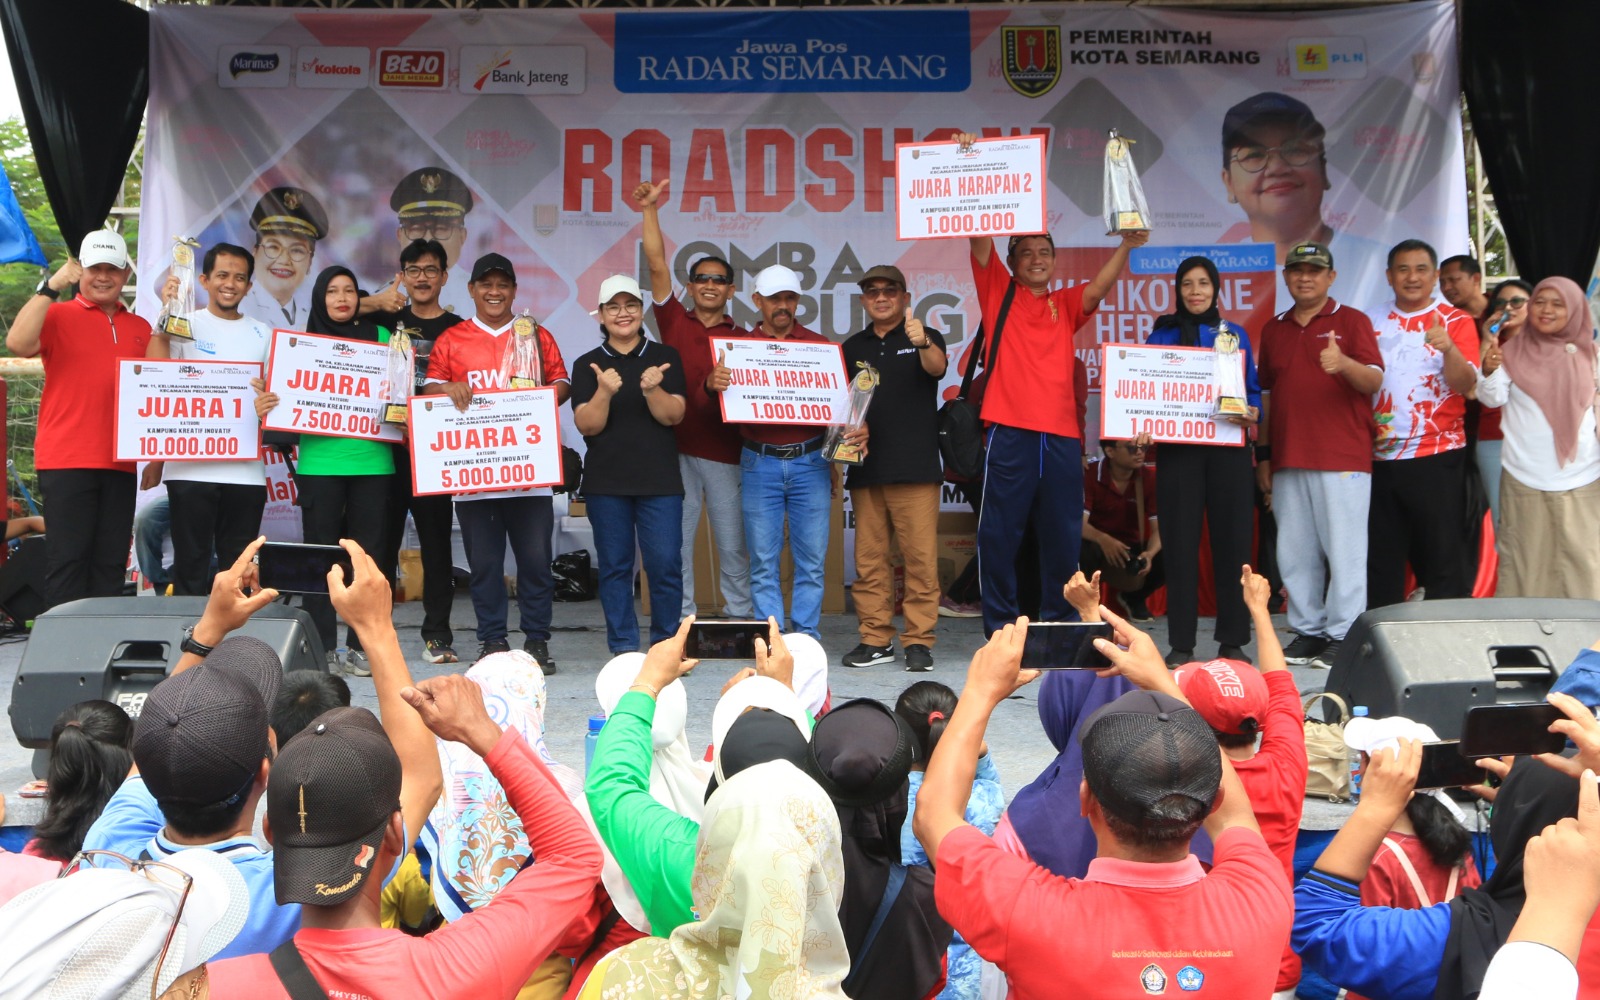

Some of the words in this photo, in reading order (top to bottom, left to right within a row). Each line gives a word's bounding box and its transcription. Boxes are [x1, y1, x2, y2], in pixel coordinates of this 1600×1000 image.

[736, 39, 798, 54] Jawa
[806, 38, 848, 54] Pos
[1069, 29, 1212, 46] PEMERINTAH
[233, 58, 275, 69] Marimas
[386, 55, 440, 74] BEJO
[1070, 50, 1129, 65] KOTA
[1135, 48, 1261, 66] SEMARANG
[1331, 53, 1364, 63] PLN
[315, 64, 361, 75] Kokola
[637, 56, 753, 82] RADAR
[761, 54, 948, 81] SEMARANG
[492, 70, 525, 83] Bank
[527, 70, 569, 86] Jateng
[562, 127, 1051, 213] ROADSH
[909, 177, 952, 199] JUARA
[958, 173, 1020, 197] HARAPAN
[1023, 172, 1032, 193] 2
[585, 220, 630, 228] SEMARANG
[926, 212, 1015, 234] 1.000.000
[1178, 221, 1222, 229] SEMARANG
[92, 243, 117, 251] CHANEL
[287, 369, 371, 398] JUARA
[730, 368, 770, 387] JUARA
[774, 369, 831, 389] HARAPAN
[831, 373, 839, 389] 1
[1114, 379, 1156, 400] JUARA
[1163, 381, 1215, 404] HARAPA
[137, 397, 224, 418] JUARA
[233, 398, 242, 418] 1
[296, 400, 326, 409] KAMPUNG
[327, 403, 351, 411] KREATIF
[751, 402, 832, 421] 1.000.000
[291, 408, 381, 436] 7.500.000
[1131, 418, 1217, 439] 1000.000
[139, 437, 239, 456] 10.000.000
[430, 426, 518, 452] JUARA
[526, 424, 541, 444] 3
[444, 459, 474, 467] KAMPUNG
[441, 463, 535, 488] 5.000.000
[315, 873, 362, 896] Komando
